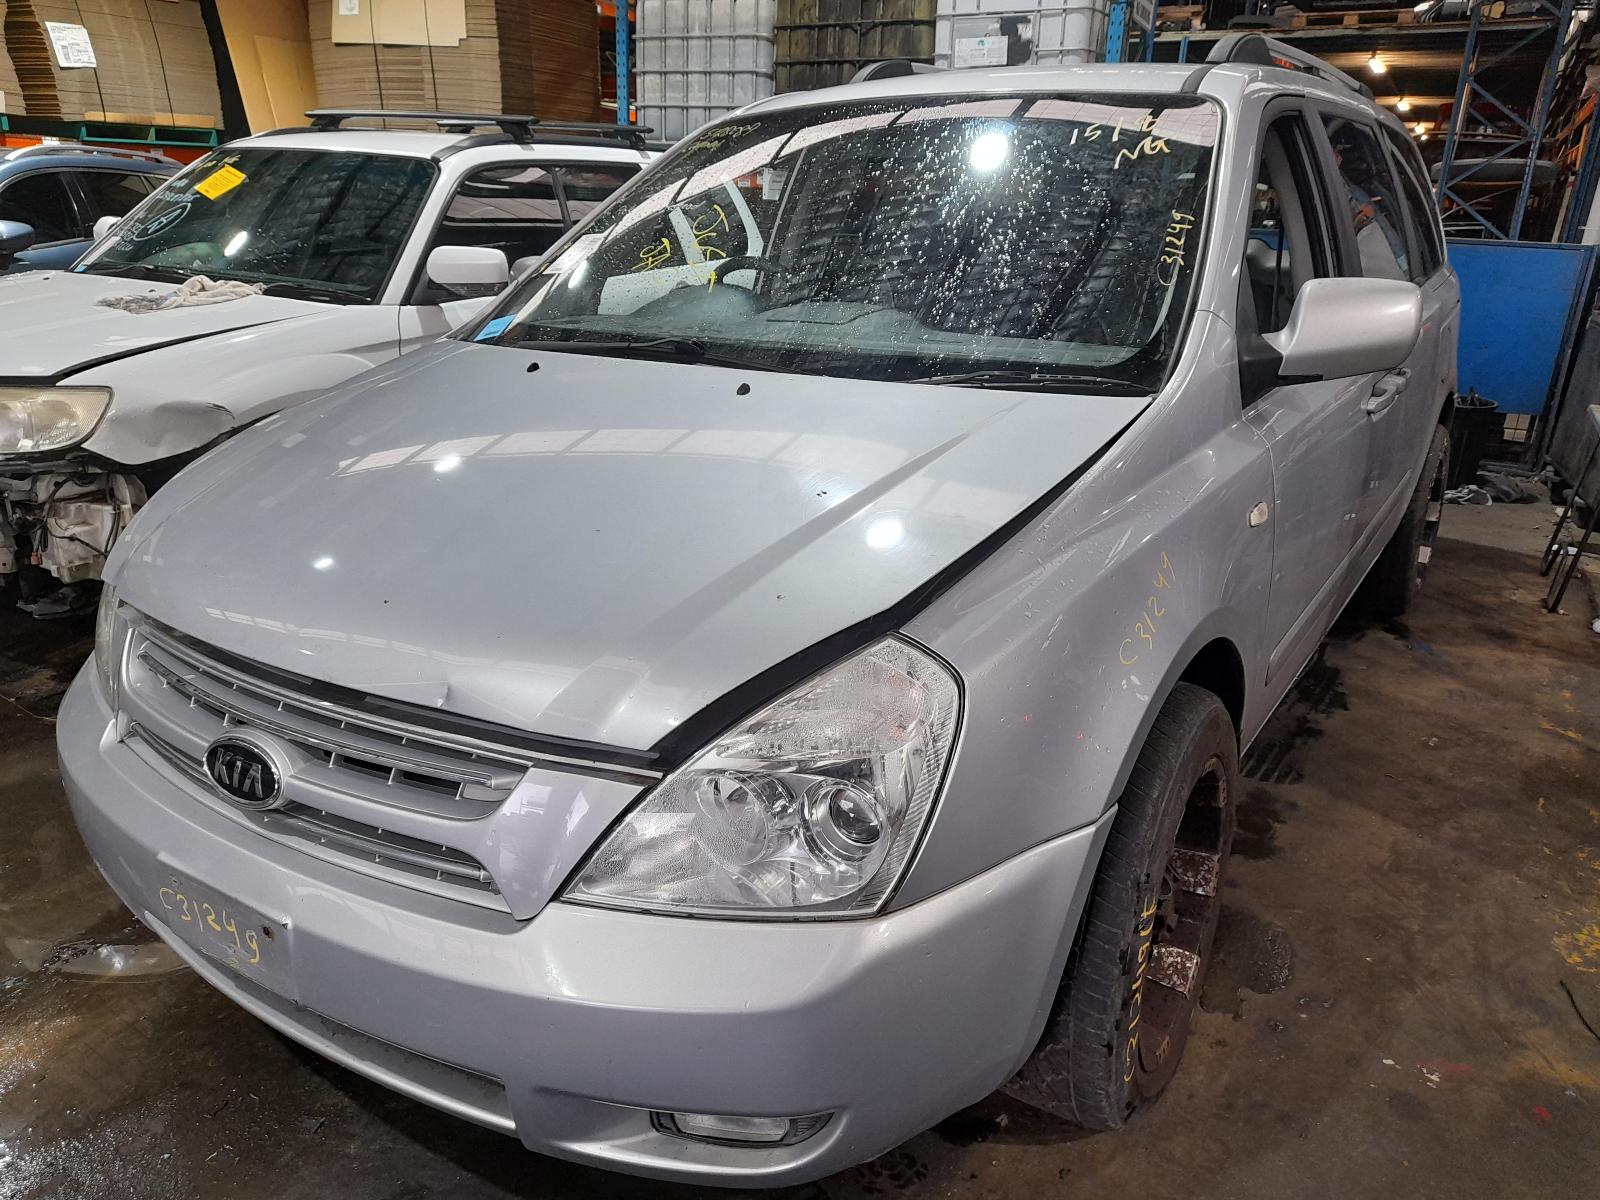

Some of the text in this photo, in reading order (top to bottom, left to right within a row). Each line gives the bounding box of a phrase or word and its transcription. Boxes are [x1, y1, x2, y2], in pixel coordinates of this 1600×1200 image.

[1156, 208, 1195, 286] C31249
[1120, 551, 1176, 665] C31249
[213, 747, 264, 799] KIA
[159, 887, 260, 965] C31249
